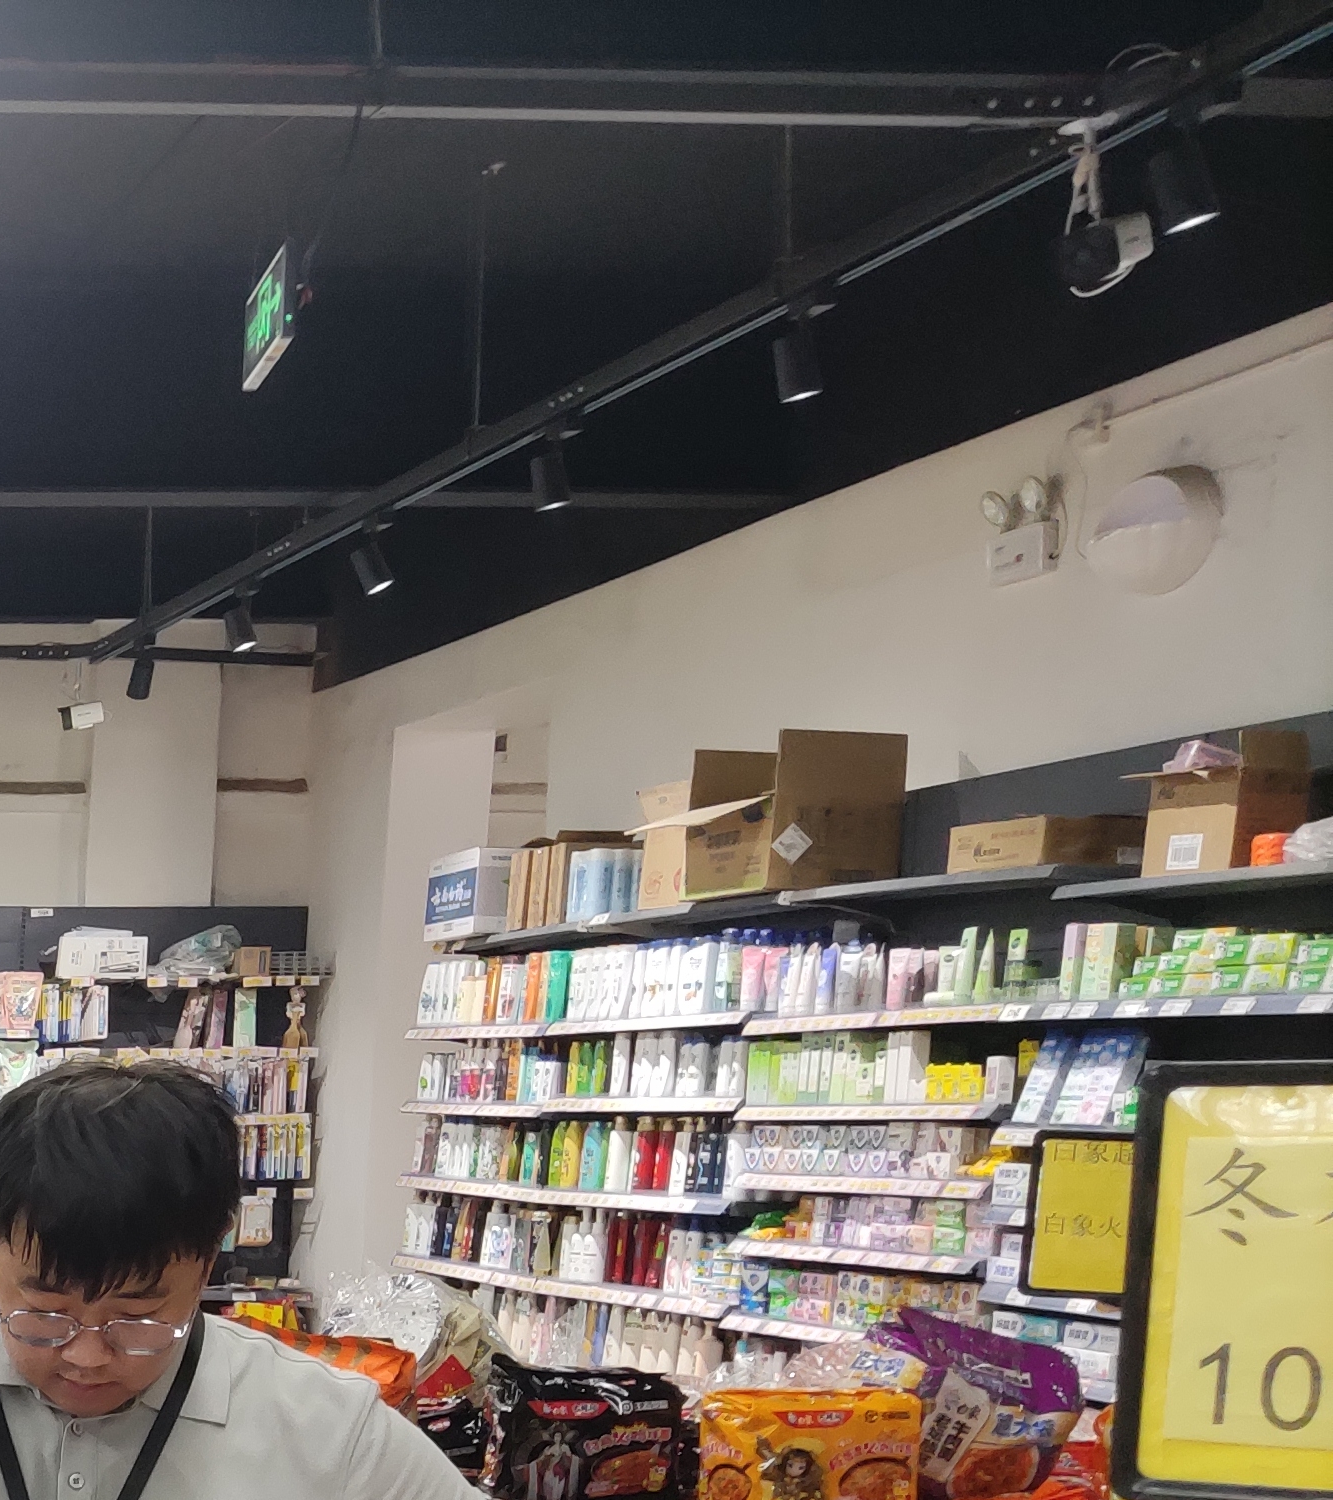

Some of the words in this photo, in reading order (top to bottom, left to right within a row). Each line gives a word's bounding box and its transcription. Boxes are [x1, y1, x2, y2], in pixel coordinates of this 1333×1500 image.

[1044, 1212, 1124, 1239] 白象火
[1199, 1343, 1323, 1431] 10
